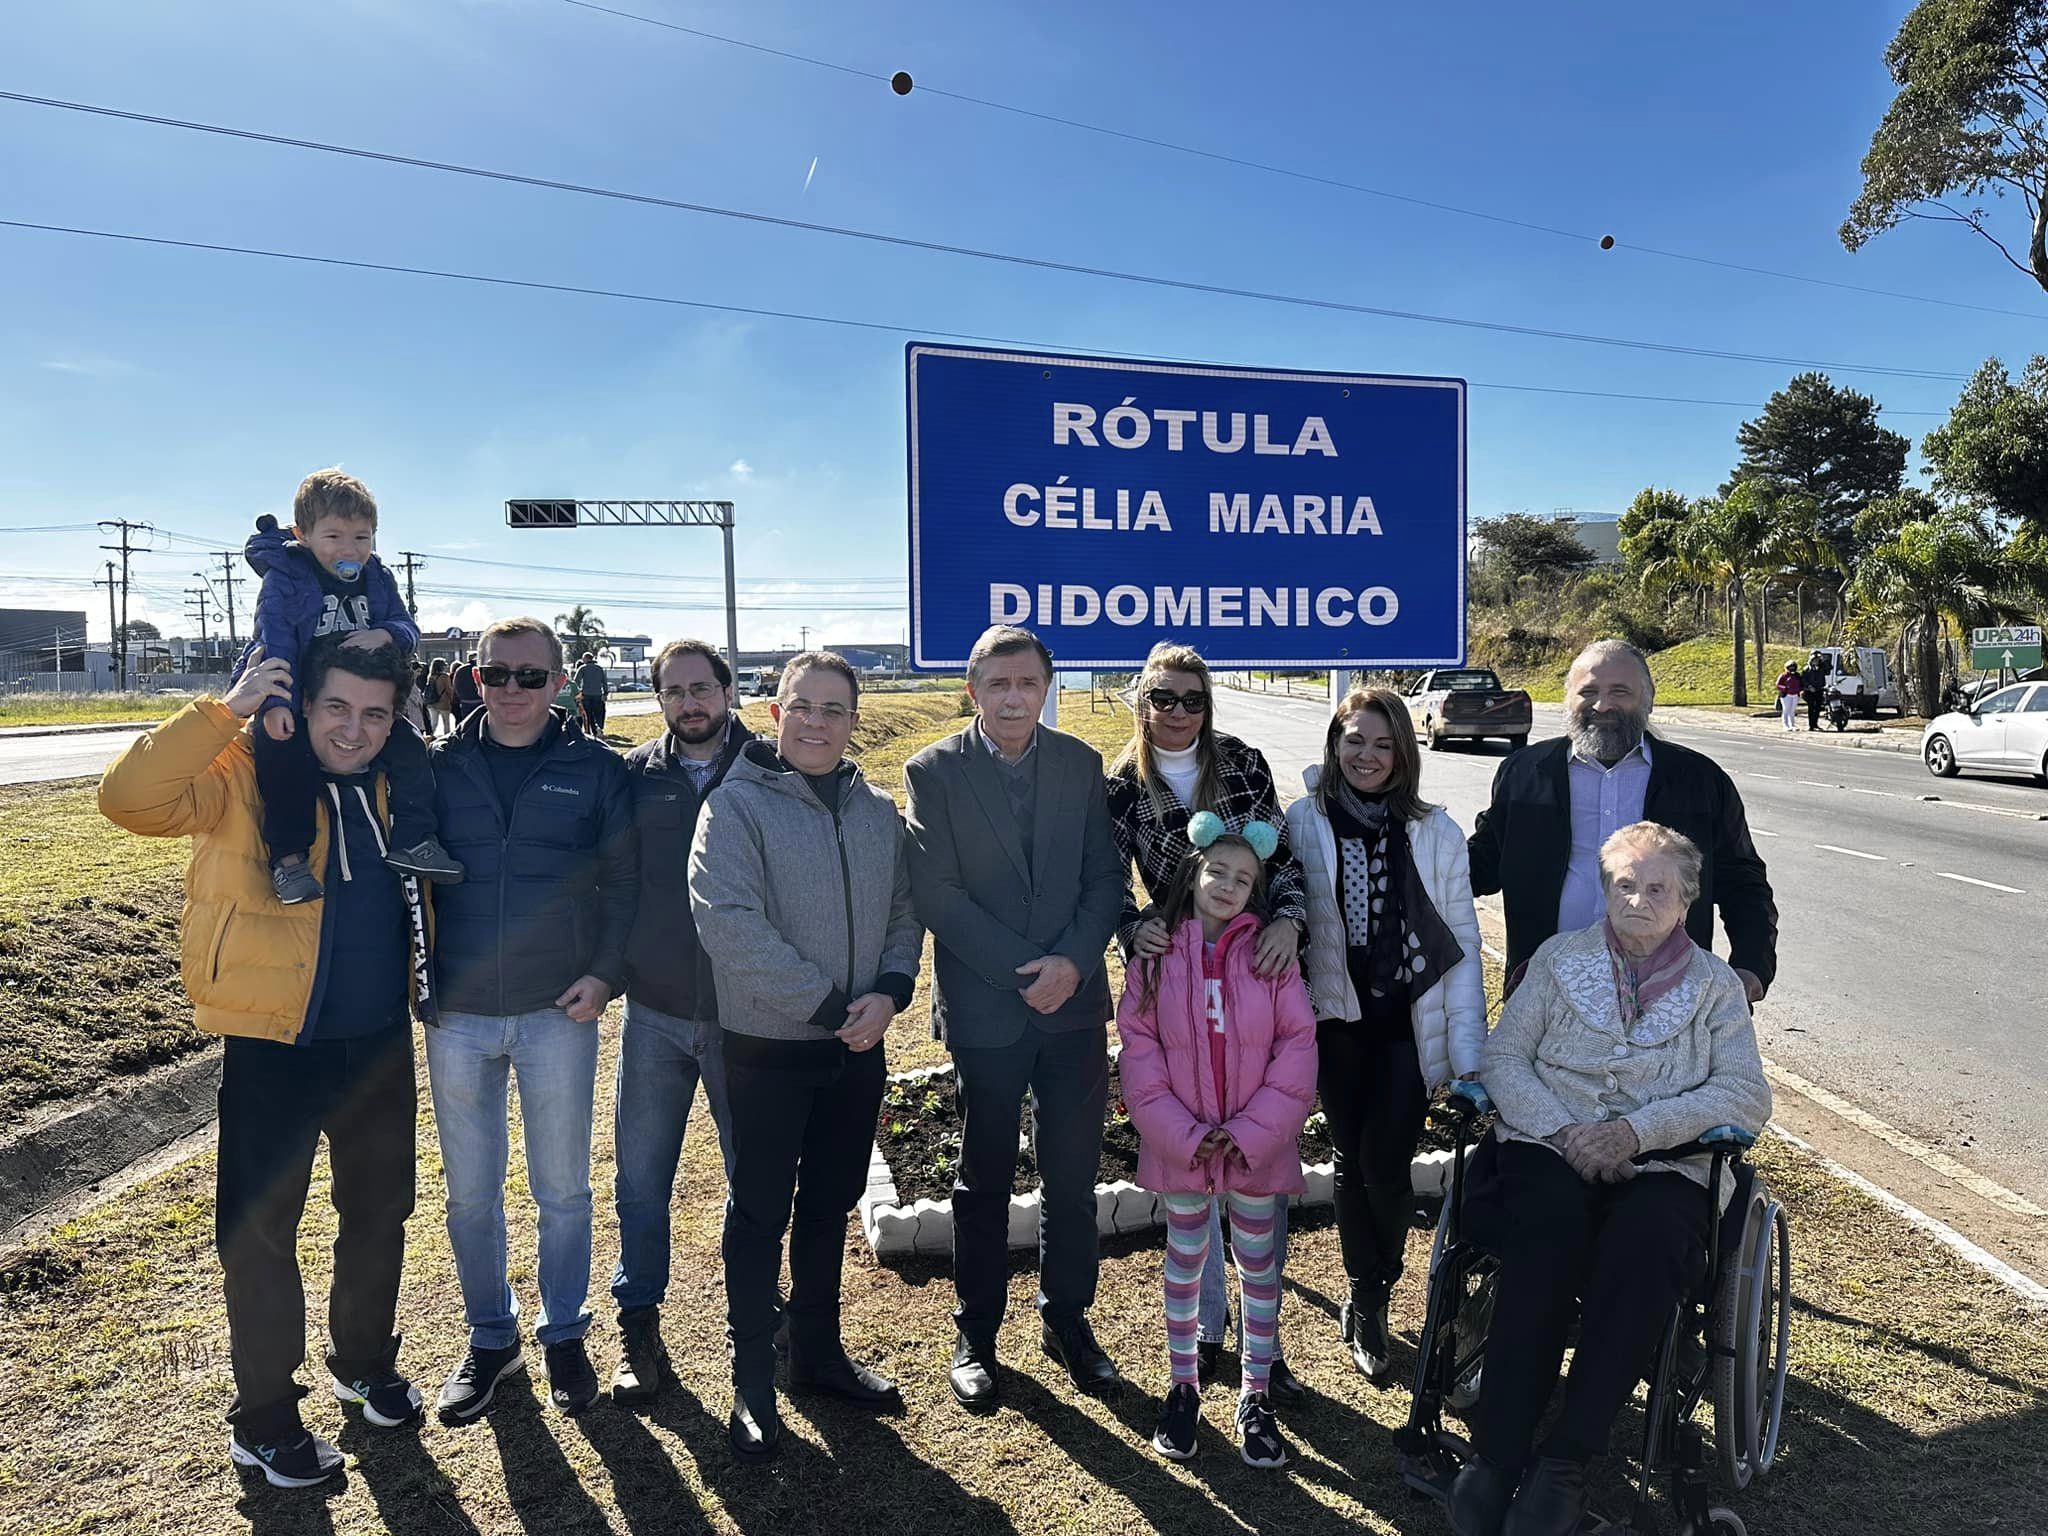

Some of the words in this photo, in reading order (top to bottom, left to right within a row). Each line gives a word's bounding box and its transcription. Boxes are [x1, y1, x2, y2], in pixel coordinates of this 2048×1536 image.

[1053, 396, 1339, 457] RÓTULA
[1003, 475, 1173, 532] CÉLIA
[1209, 492, 1383, 536] MARIA
[989, 582, 1400, 627] DIDOMENICO
[1975, 628, 2014, 643] UPA
[549, 784, 580, 797] Columbia
